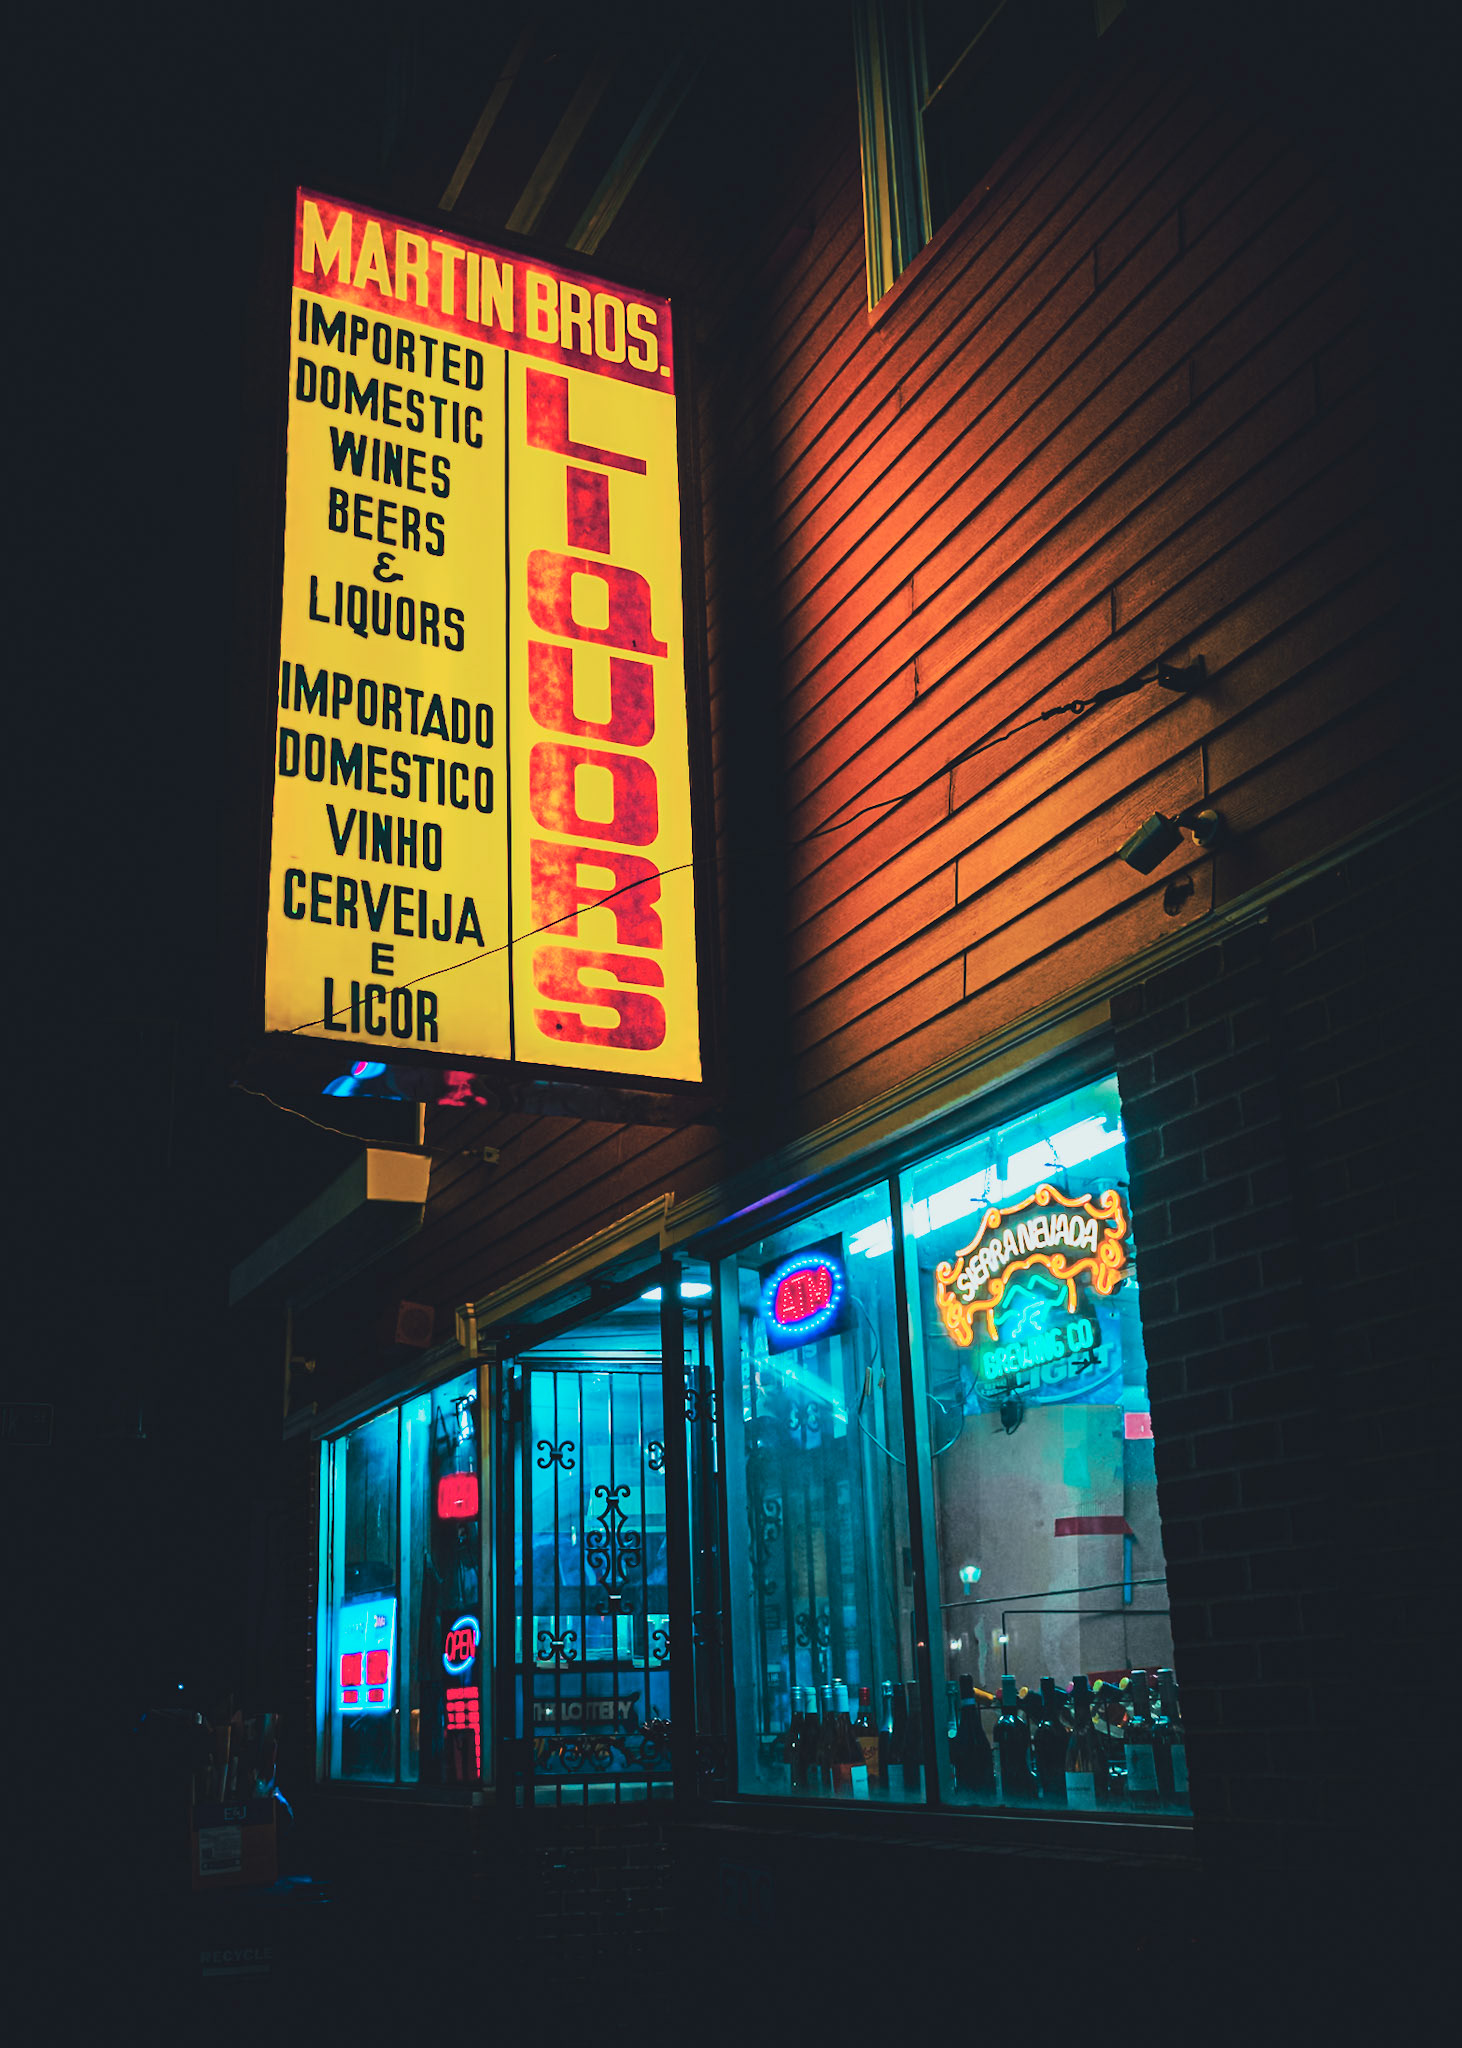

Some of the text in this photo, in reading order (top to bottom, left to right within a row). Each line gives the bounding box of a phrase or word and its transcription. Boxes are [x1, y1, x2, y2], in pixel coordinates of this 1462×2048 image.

[301, 200, 671, 378] MARTIN BROS.
[298, 298, 484, 392] IMPORTED
[295, 356, 483, 449] DOMESTIC
[329, 425, 451, 499] WINES
[328, 486, 445, 557] BEERS
[372, 551, 404, 583] &
[309, 574, 465, 652] LIQUORS
[280, 660, 494, 750] IMPORTADO
[526, 366, 669, 1052] LIQUORS
[278, 726, 494, 814] DOMESTICO
[325, 803, 442, 872] VINHO
[283, 868, 486, 948] CERVEIJA
[371, 941, 395, 977] E
[323, 976, 439, 1043] LICOR
[781, 1266, 830, 1324] ATM
[957, 1213, 1099, 1302] SIERRA NEVADA
[1067, 1318, 1094, 1353] CO
[445, 1629, 476, 1662] OPEN
